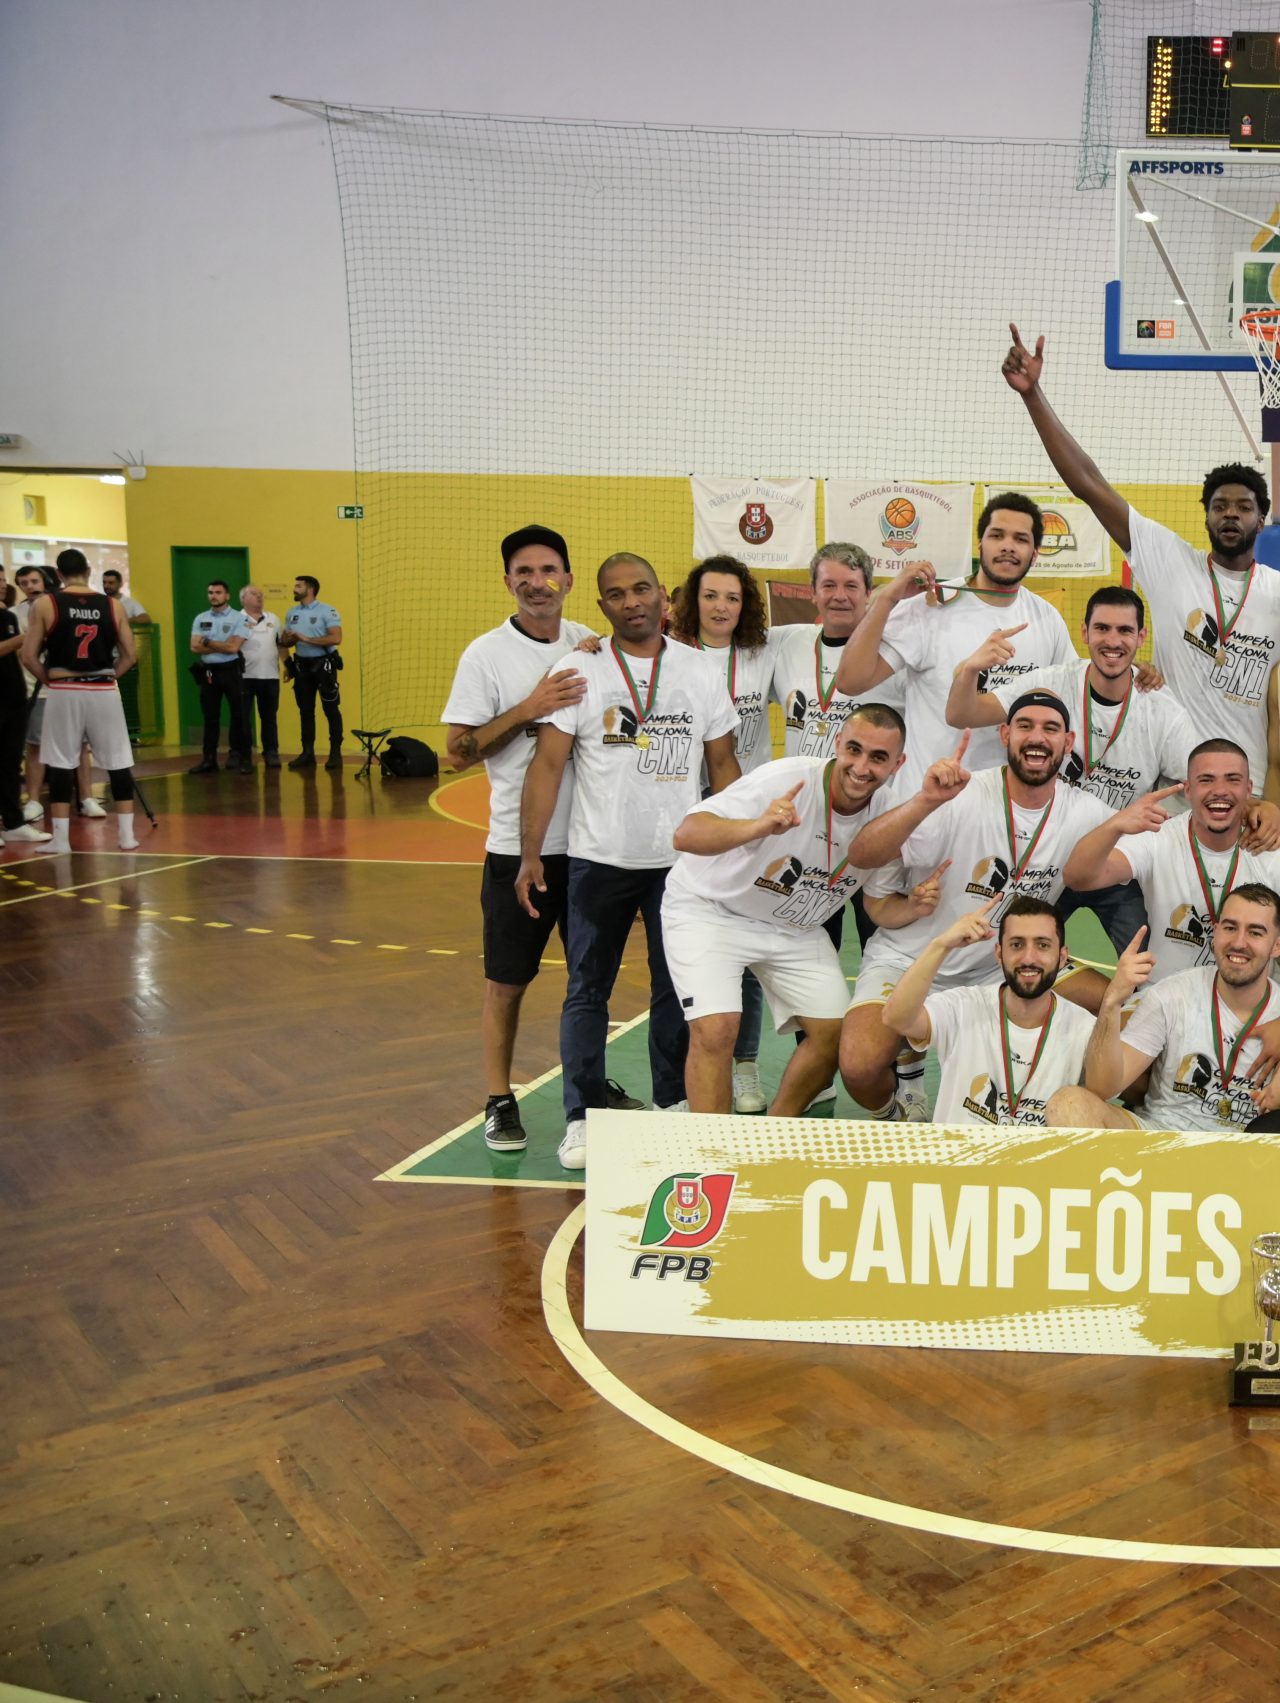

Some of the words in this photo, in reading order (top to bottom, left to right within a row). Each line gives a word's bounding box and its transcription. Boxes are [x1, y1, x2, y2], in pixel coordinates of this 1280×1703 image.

[1129, 161, 1224, 175] AFFSPORTS
[849, 486, 891, 509] ASSOCIAÇÃO
[893, 485, 902, 494] DE
[905, 486, 953, 513] BASQUETEBOL
[887, 530, 914, 540] ABS
[69, 608, 101, 619] PAULO
[75, 624, 98, 658] 7
[1229, 630, 1275, 649] AMPEÃO
[645, 711, 694, 724] AMPEÃO
[642, 727, 694, 736] NACIONAL
[1097, 763, 1141, 780] AMPEÃO
[1088, 774, 1136, 790] NACIONAL
[755, 879, 793, 896] BASKETBALL
[801, 1166, 1242, 1296] CAMPEÕES
[629, 1252, 714, 1283] FPB
